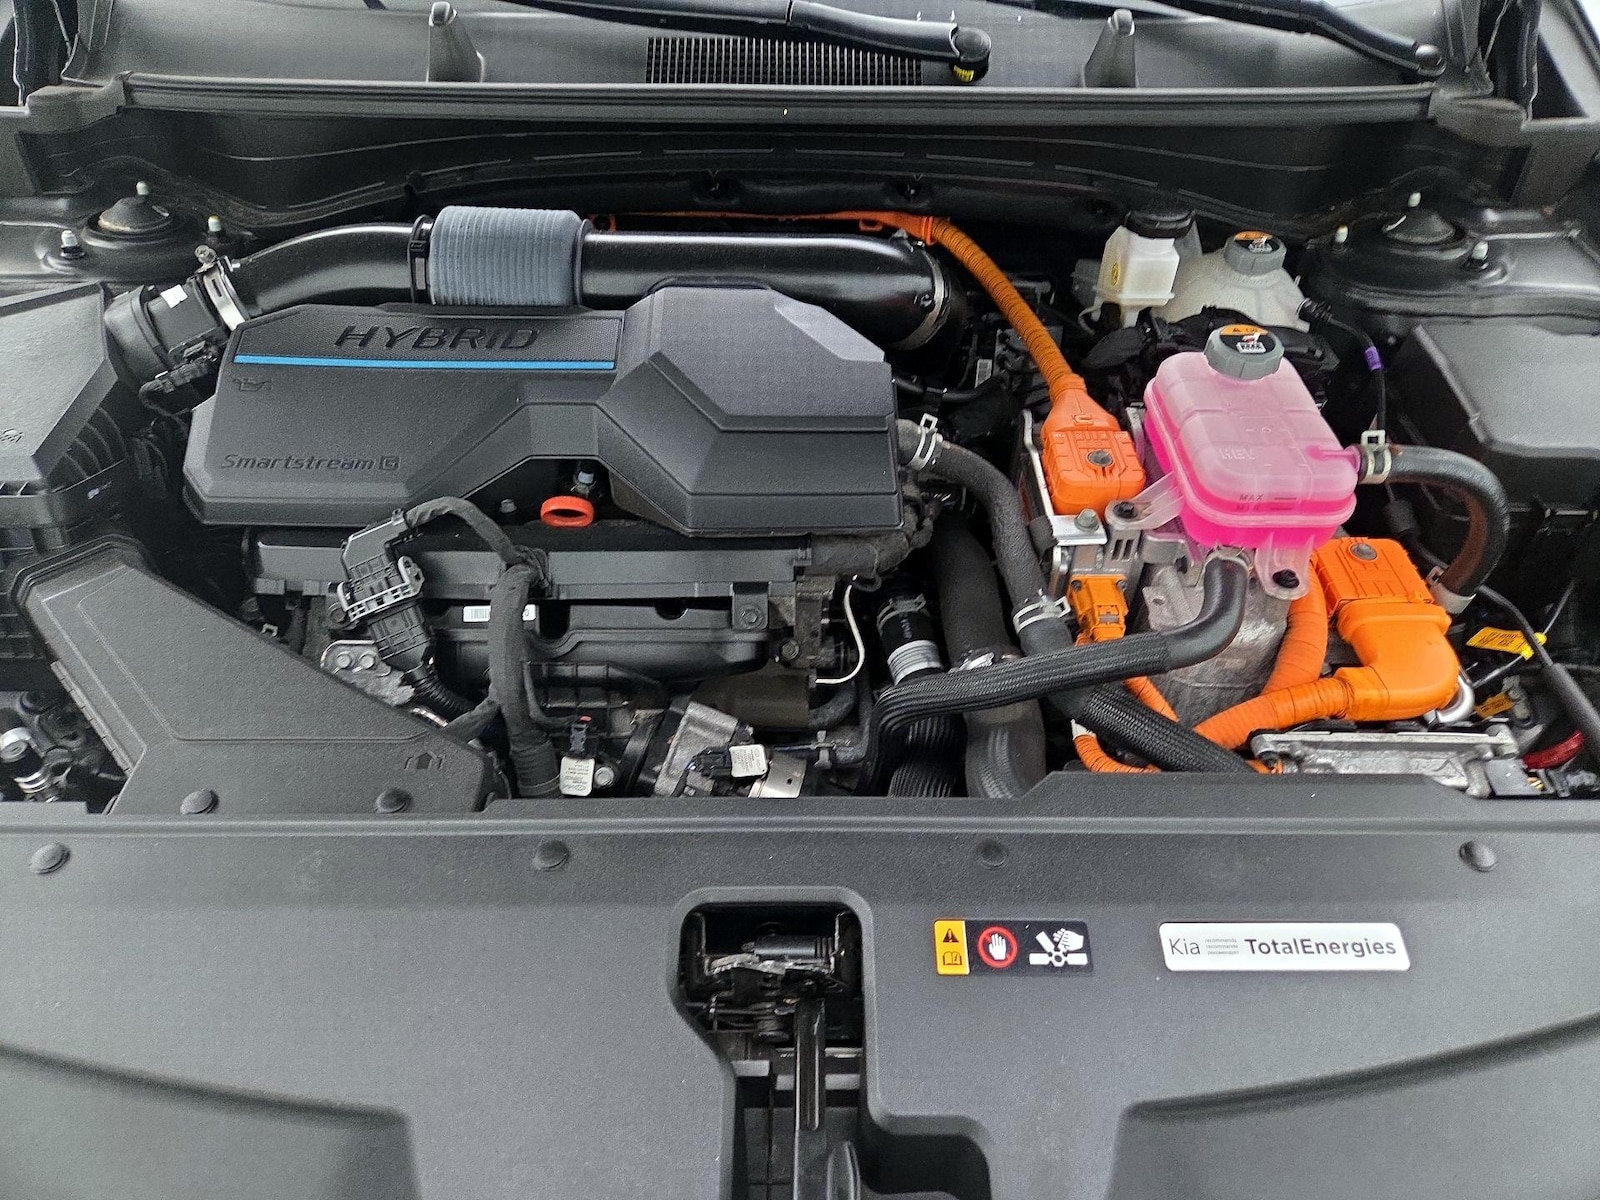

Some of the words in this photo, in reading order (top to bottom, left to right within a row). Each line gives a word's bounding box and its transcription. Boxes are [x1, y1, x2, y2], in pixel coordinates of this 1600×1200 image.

[334, 325, 540, 349] HYBRID
[221, 454, 374, 470] Smartstream
[1169, 938, 1200, 955] Kia
[1244, 937, 1397, 957] TotalEnergies
